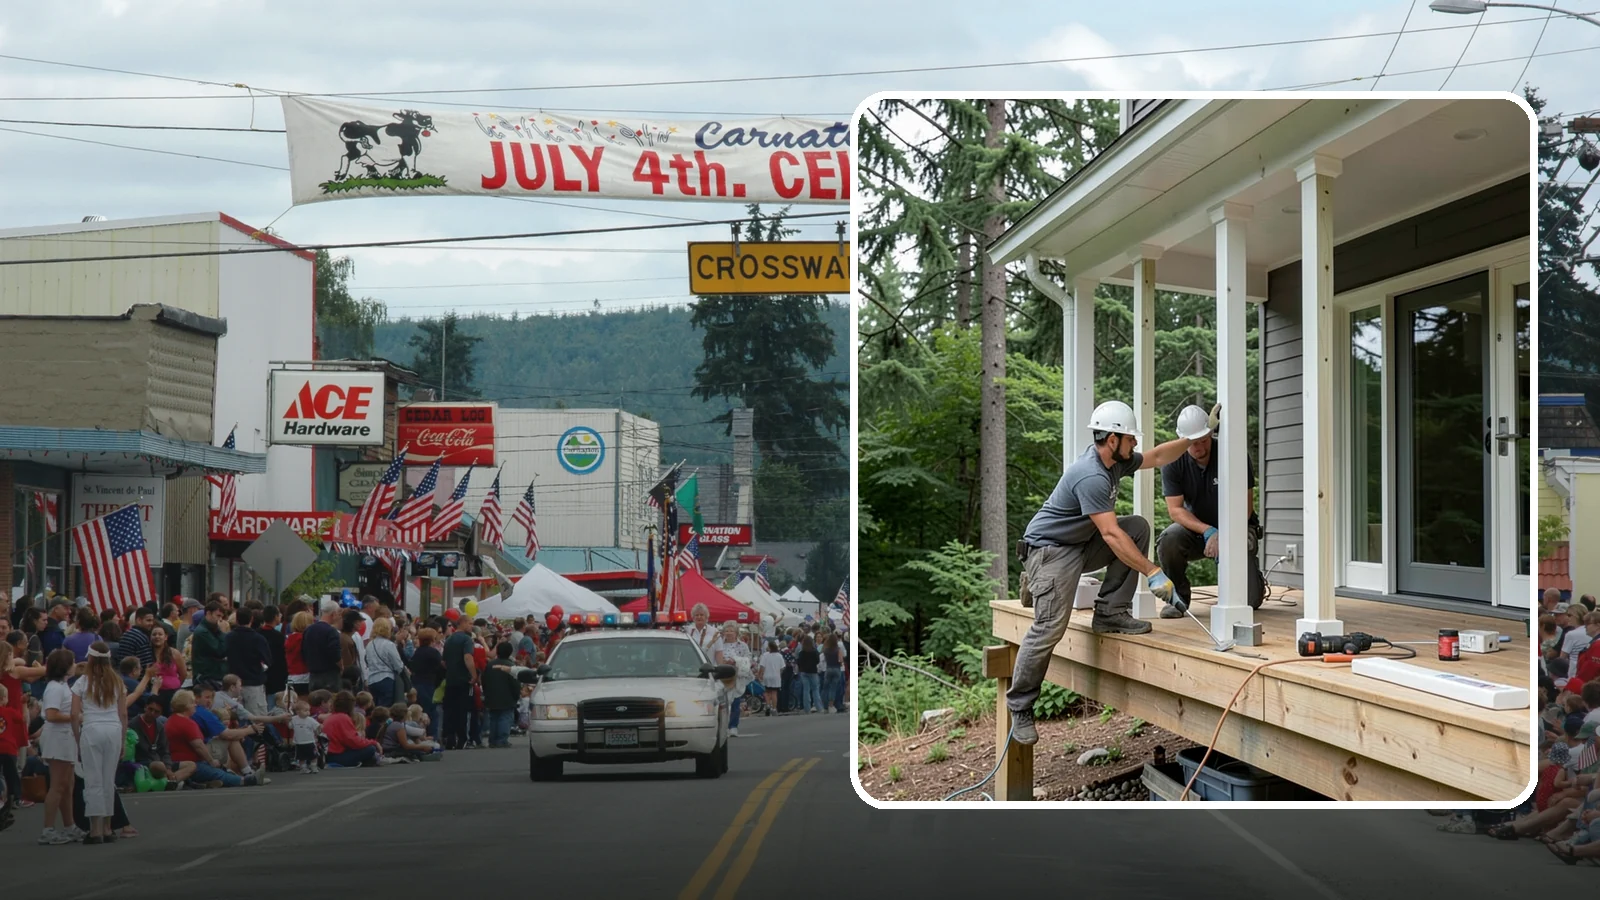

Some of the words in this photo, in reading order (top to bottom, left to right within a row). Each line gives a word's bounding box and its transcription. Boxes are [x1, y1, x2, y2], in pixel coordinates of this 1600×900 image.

[481, 140, 605, 192] JULY
[632, 150, 746, 198] 4th.
[697, 254, 850, 280] CROSSWA
[282, 380, 373, 420] ACE
[406, 409, 452, 422] CEDAR
[461, 409, 485, 422] LOG
[283, 421, 371, 437] Hardware
[416, 428, 477, 447] Coca-Cola
[96, 485, 124, 495] Vincent
[126, 486, 136, 495] de
[138, 486, 155, 495] Paul
[688, 526, 741, 535] CRNATION
[699, 535, 730, 544] GLASS
